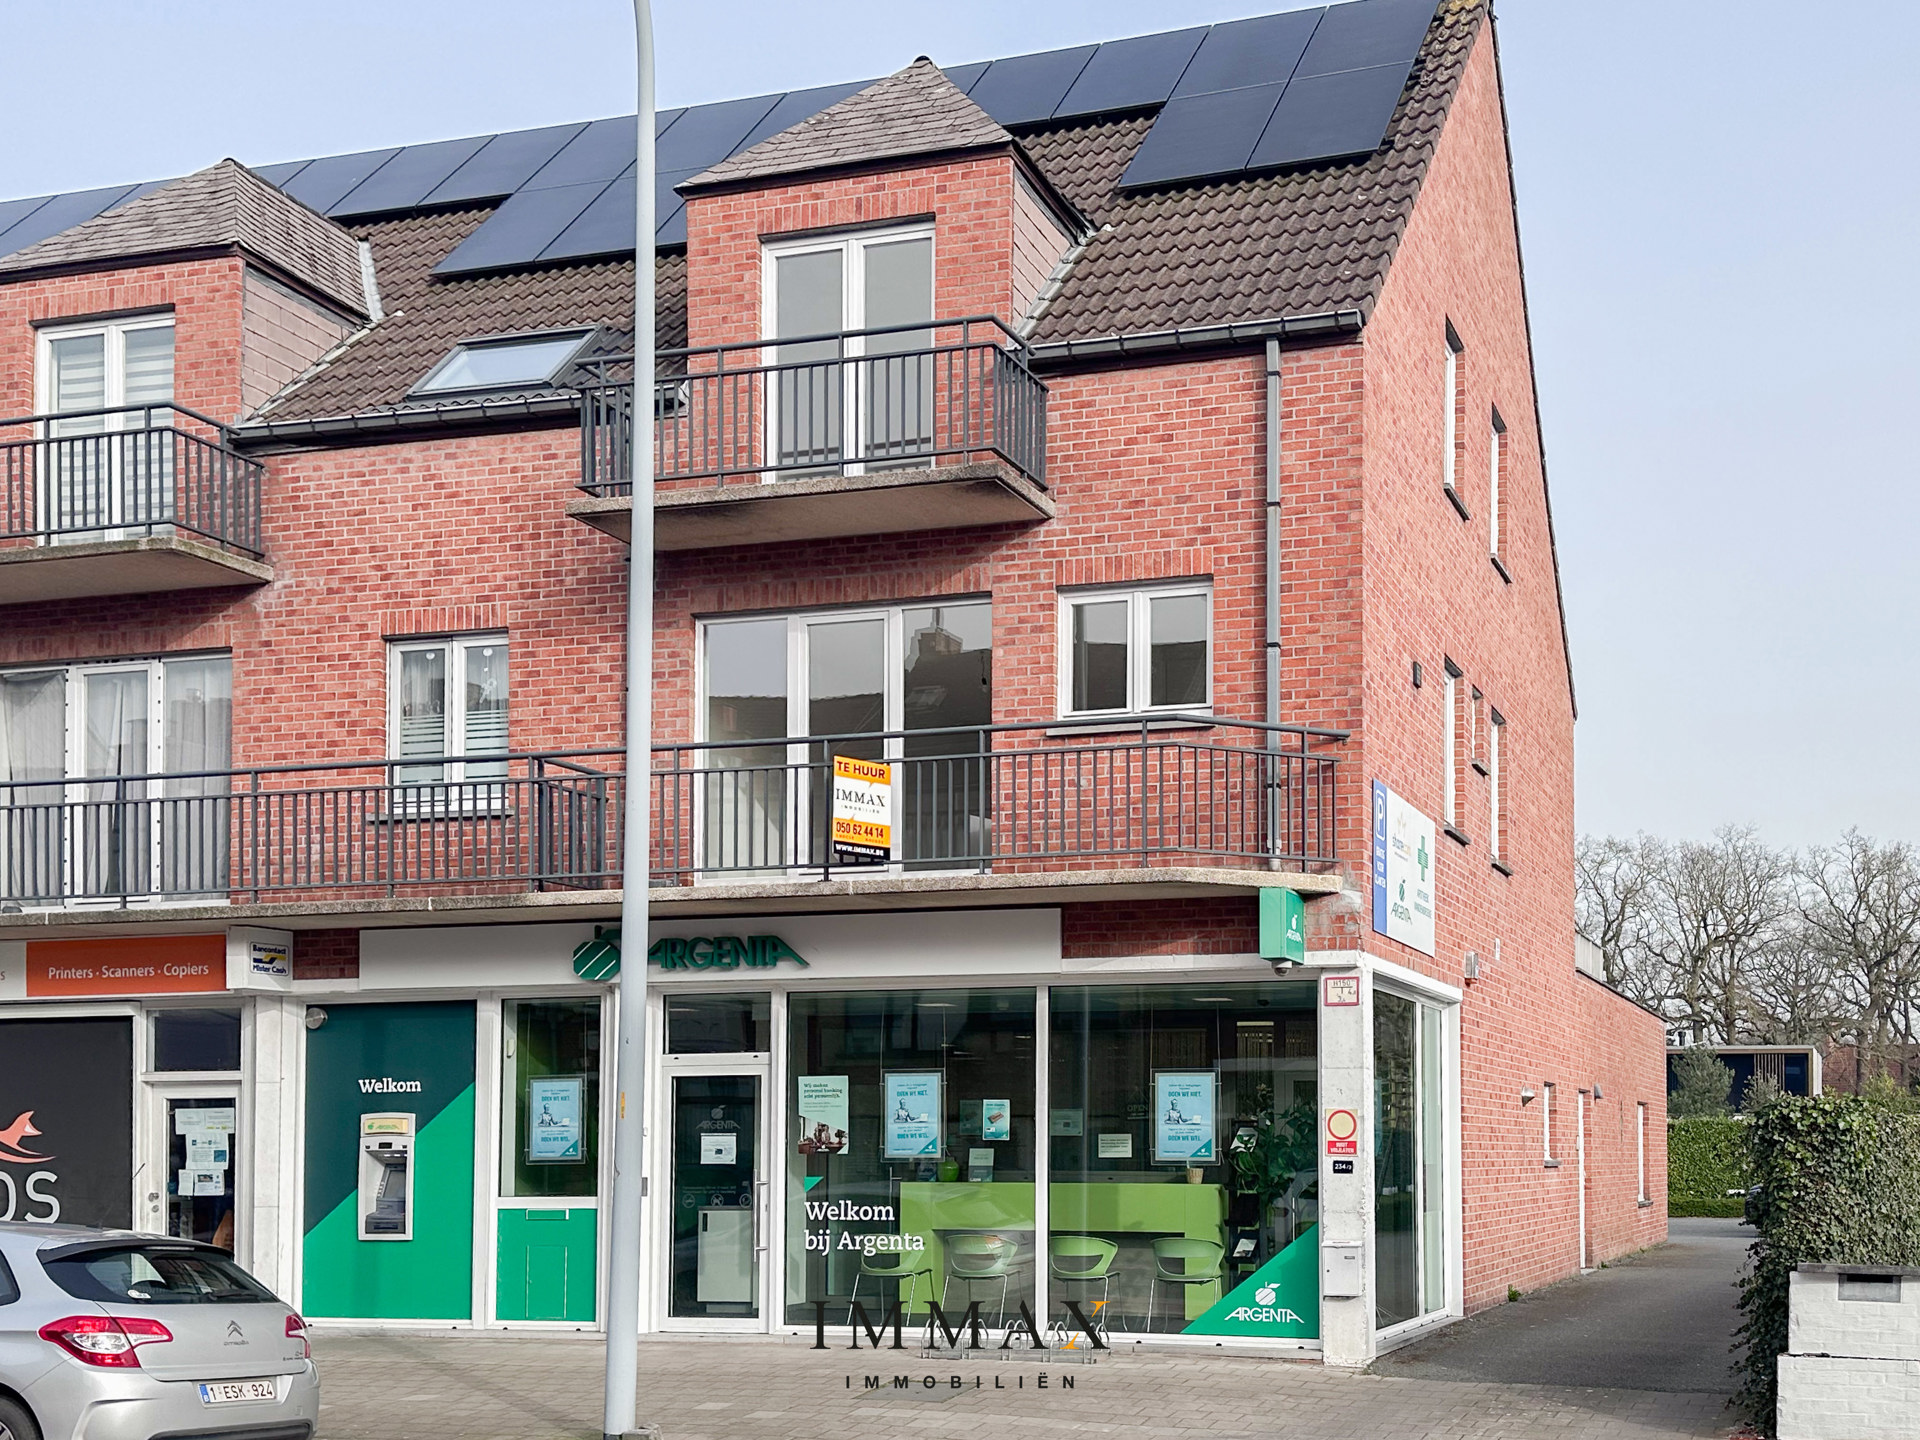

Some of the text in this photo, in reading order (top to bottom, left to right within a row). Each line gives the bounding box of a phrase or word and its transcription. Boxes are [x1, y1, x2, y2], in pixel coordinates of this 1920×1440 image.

[837, 761, 885, 779] TE HUUR
[836, 788, 885, 807] IMMAX
[836, 822, 884, 838] 050 62 44 14
[648, 934, 810, 969] ARGENTA
[48, 963, 209, 979] Printers Scanners Copiers
[272, 965, 287, 974] Cash
[358, 1078, 422, 1093] Welkom
[695, 1120, 741, 1130] ARGENTA
[804, 1200, 895, 1221] Welkom
[804, 1229, 925, 1257] bij Argenta
[1224, 1306, 1305, 1324] ARGENTA
